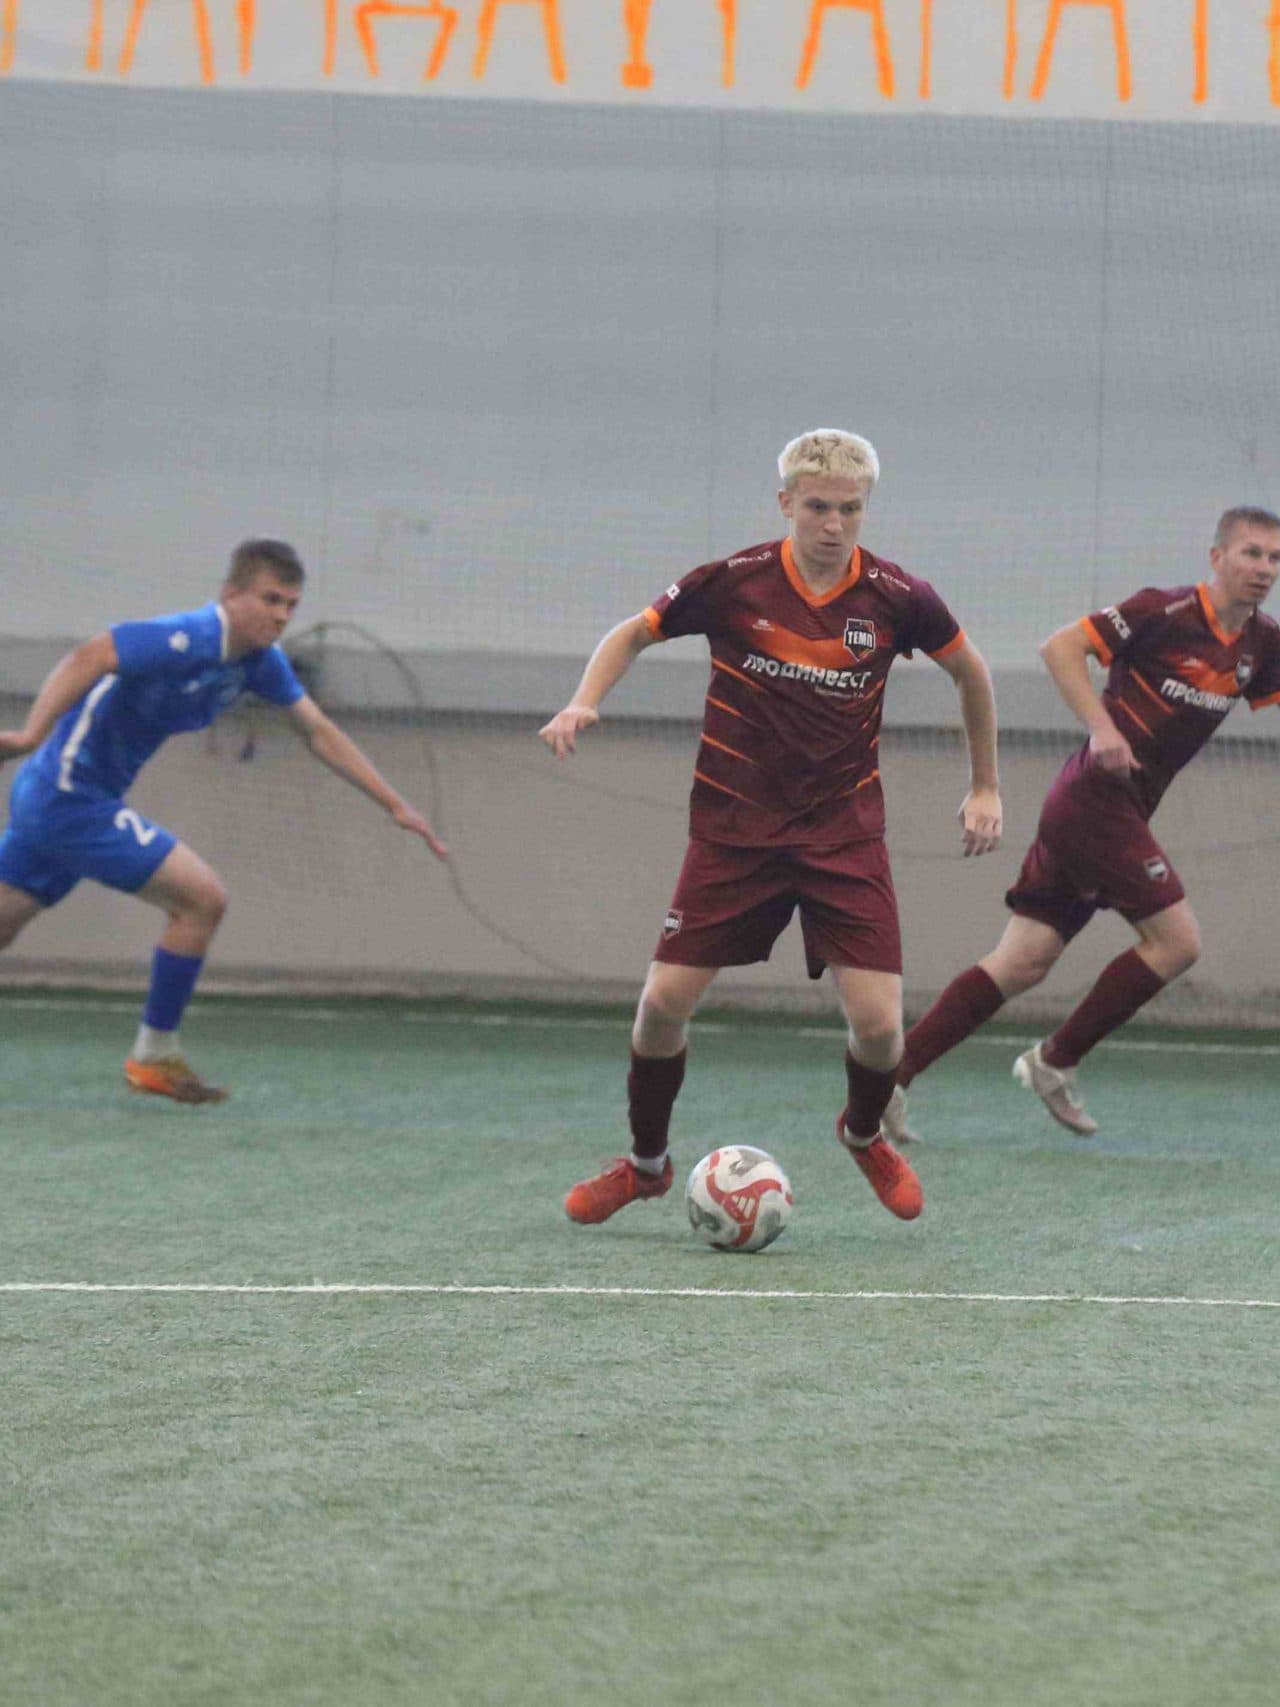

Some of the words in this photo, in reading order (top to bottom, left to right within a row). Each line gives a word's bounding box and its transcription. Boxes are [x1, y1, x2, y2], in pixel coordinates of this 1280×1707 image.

[847, 630, 874, 648] ТЕМП
[742, 653, 872, 689] ПРОДИНВЕСТ
[114, 807, 155, 846] 2
